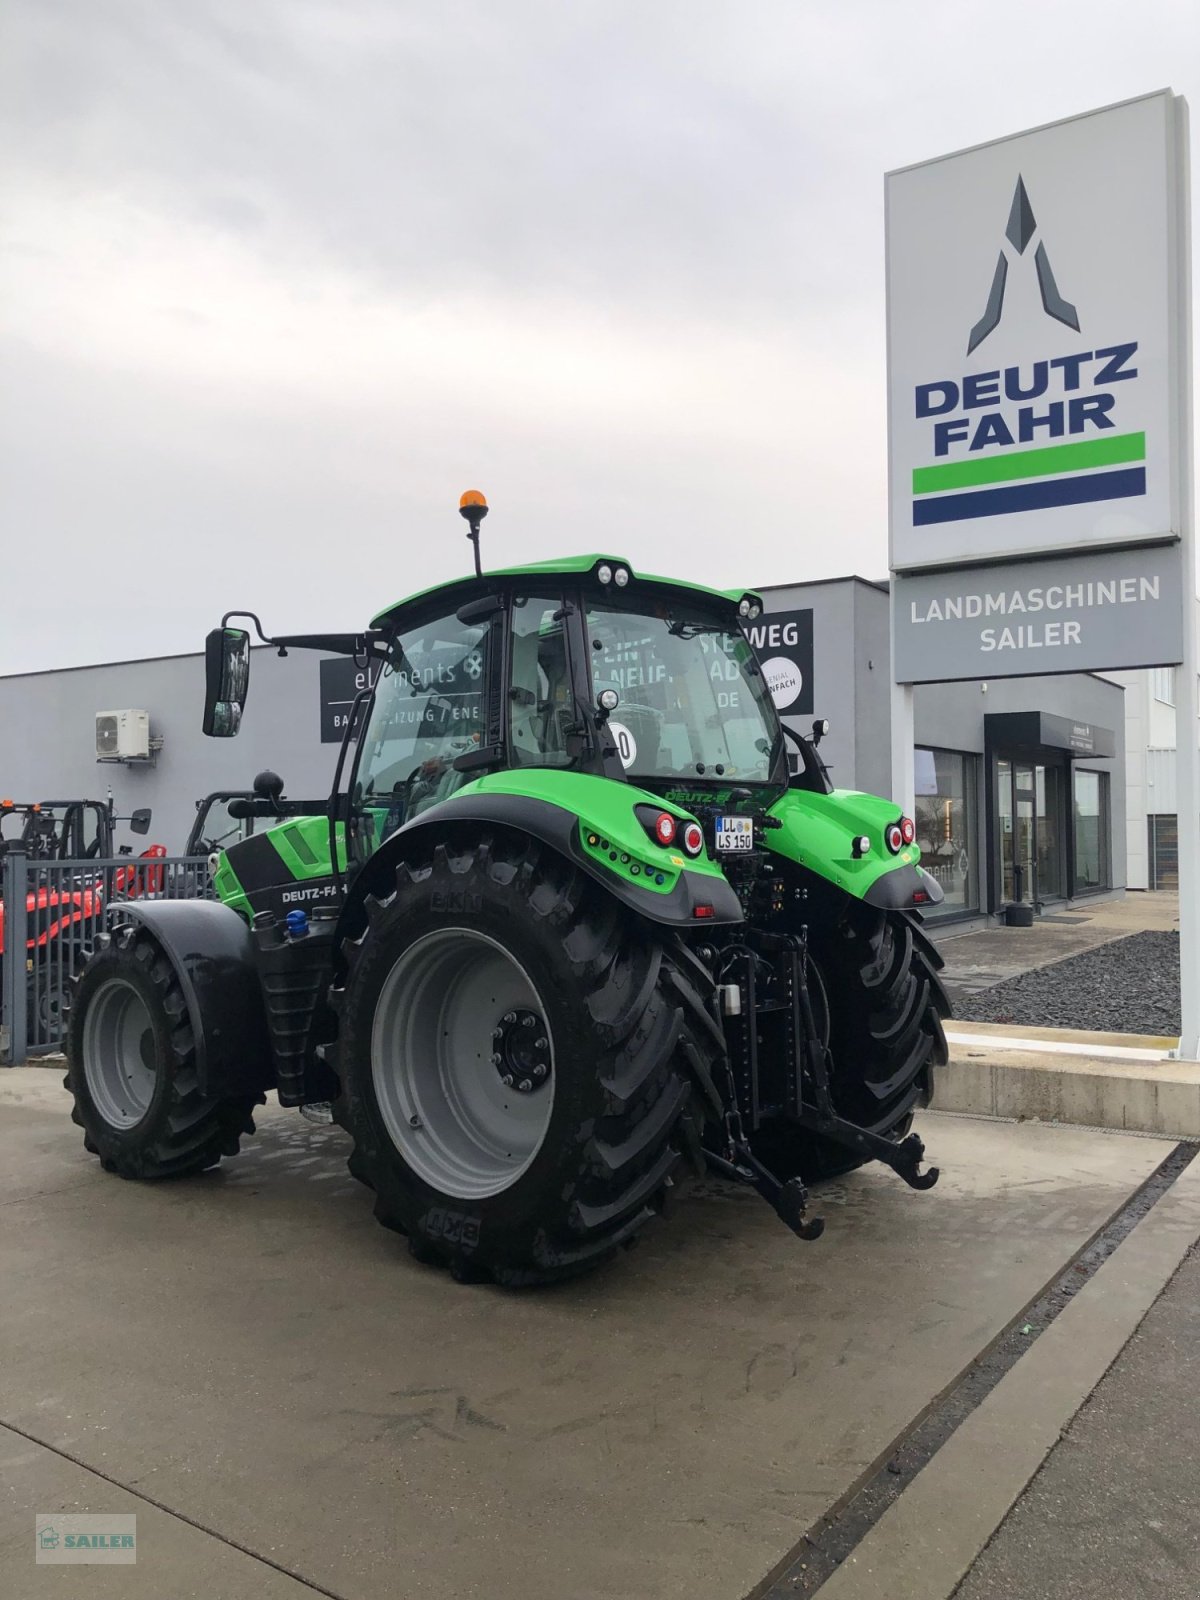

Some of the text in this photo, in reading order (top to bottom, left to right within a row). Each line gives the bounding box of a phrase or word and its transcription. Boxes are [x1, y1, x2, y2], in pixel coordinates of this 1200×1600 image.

[915, 341, 1138, 419] DEUTZ
[934, 393, 1116, 456] FAHR
[911, 576, 1160, 623] LANDMASCHINEN
[980, 622, 1082, 651] SAILER
[718, 834, 751, 848] LS 150
[724, 819, 736, 832] LL
